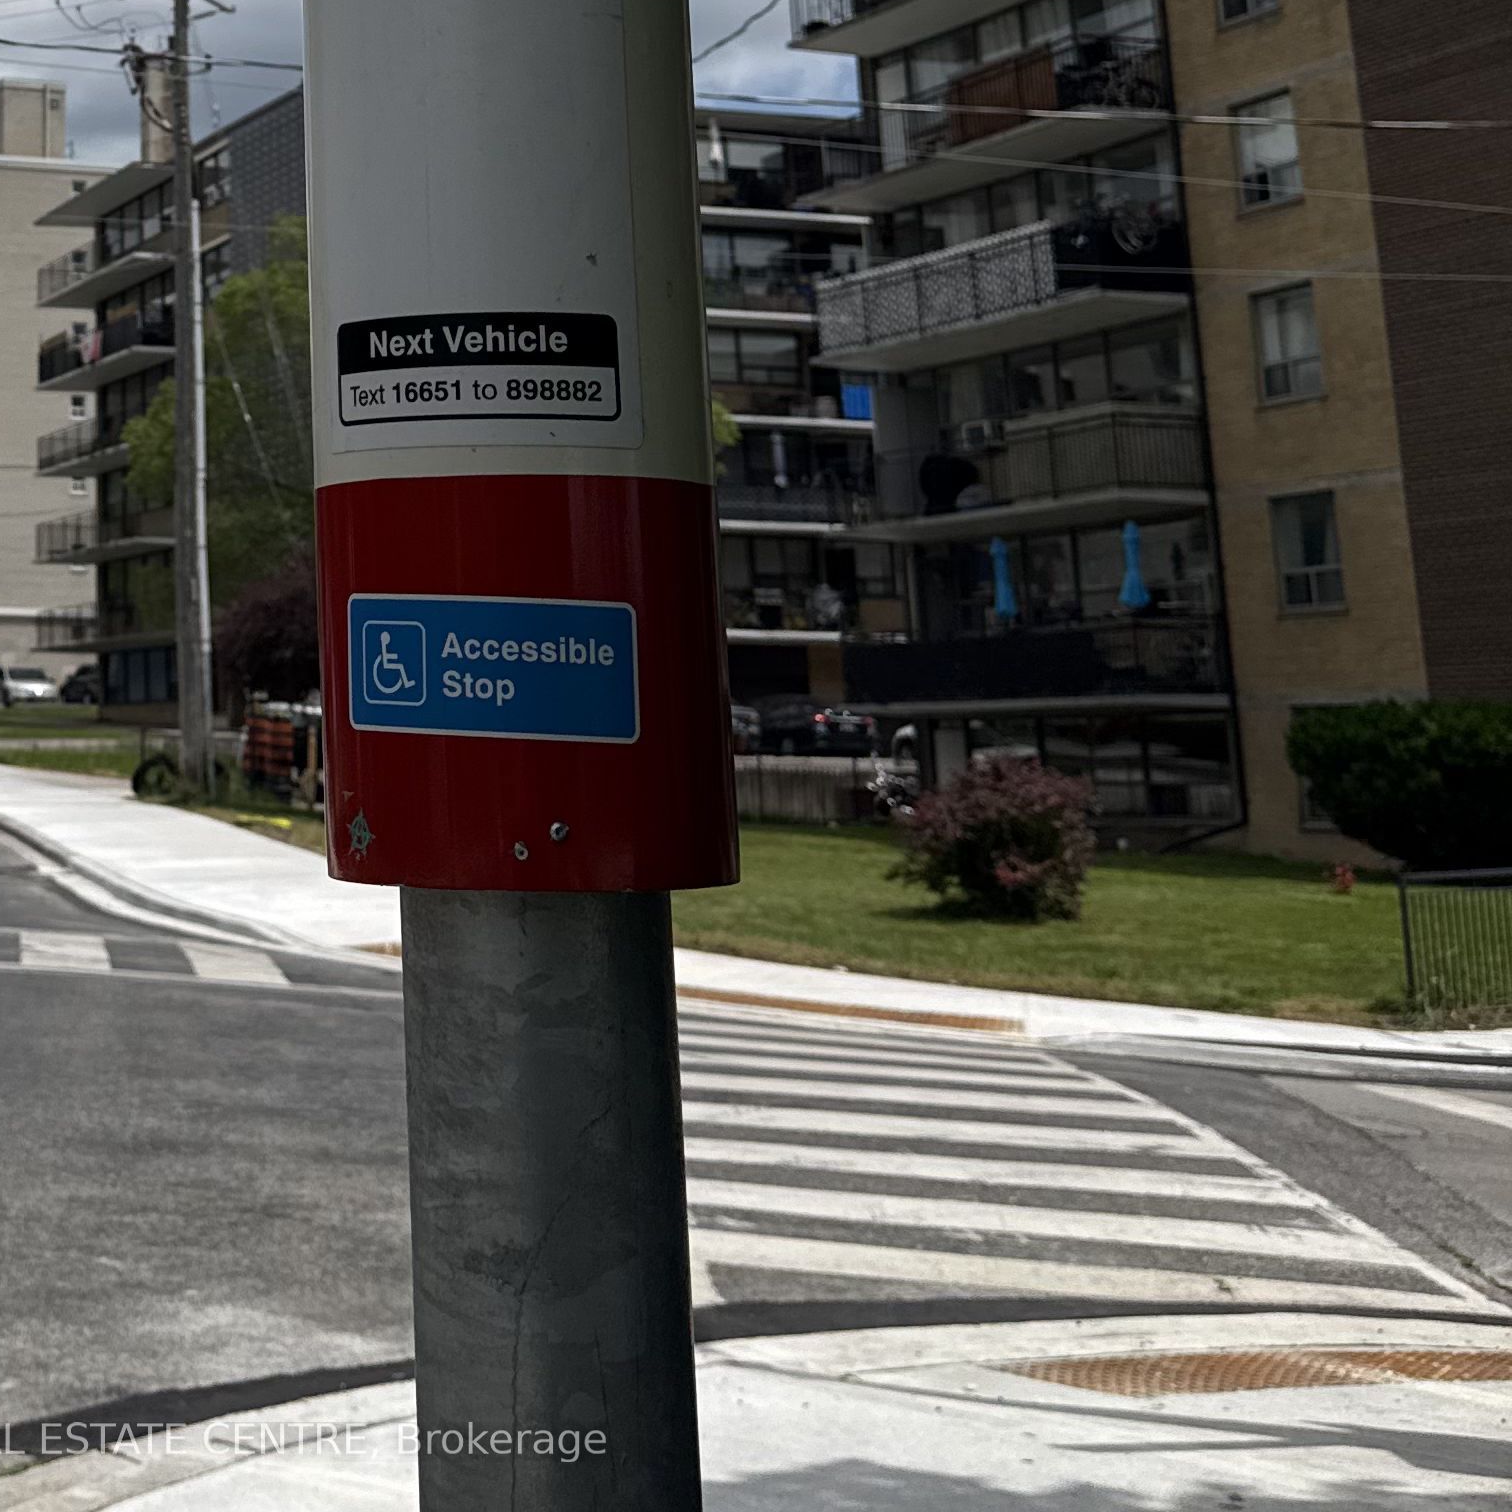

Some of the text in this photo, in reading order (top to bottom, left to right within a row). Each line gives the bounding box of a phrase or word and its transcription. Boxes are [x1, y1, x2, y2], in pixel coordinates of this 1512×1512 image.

[369, 324, 568, 358] Next Vehicle
[350, 378, 602, 407] Text 16651 to 898882
[441, 632, 614, 666] Accessible
[442, 670, 515, 705] Stop
